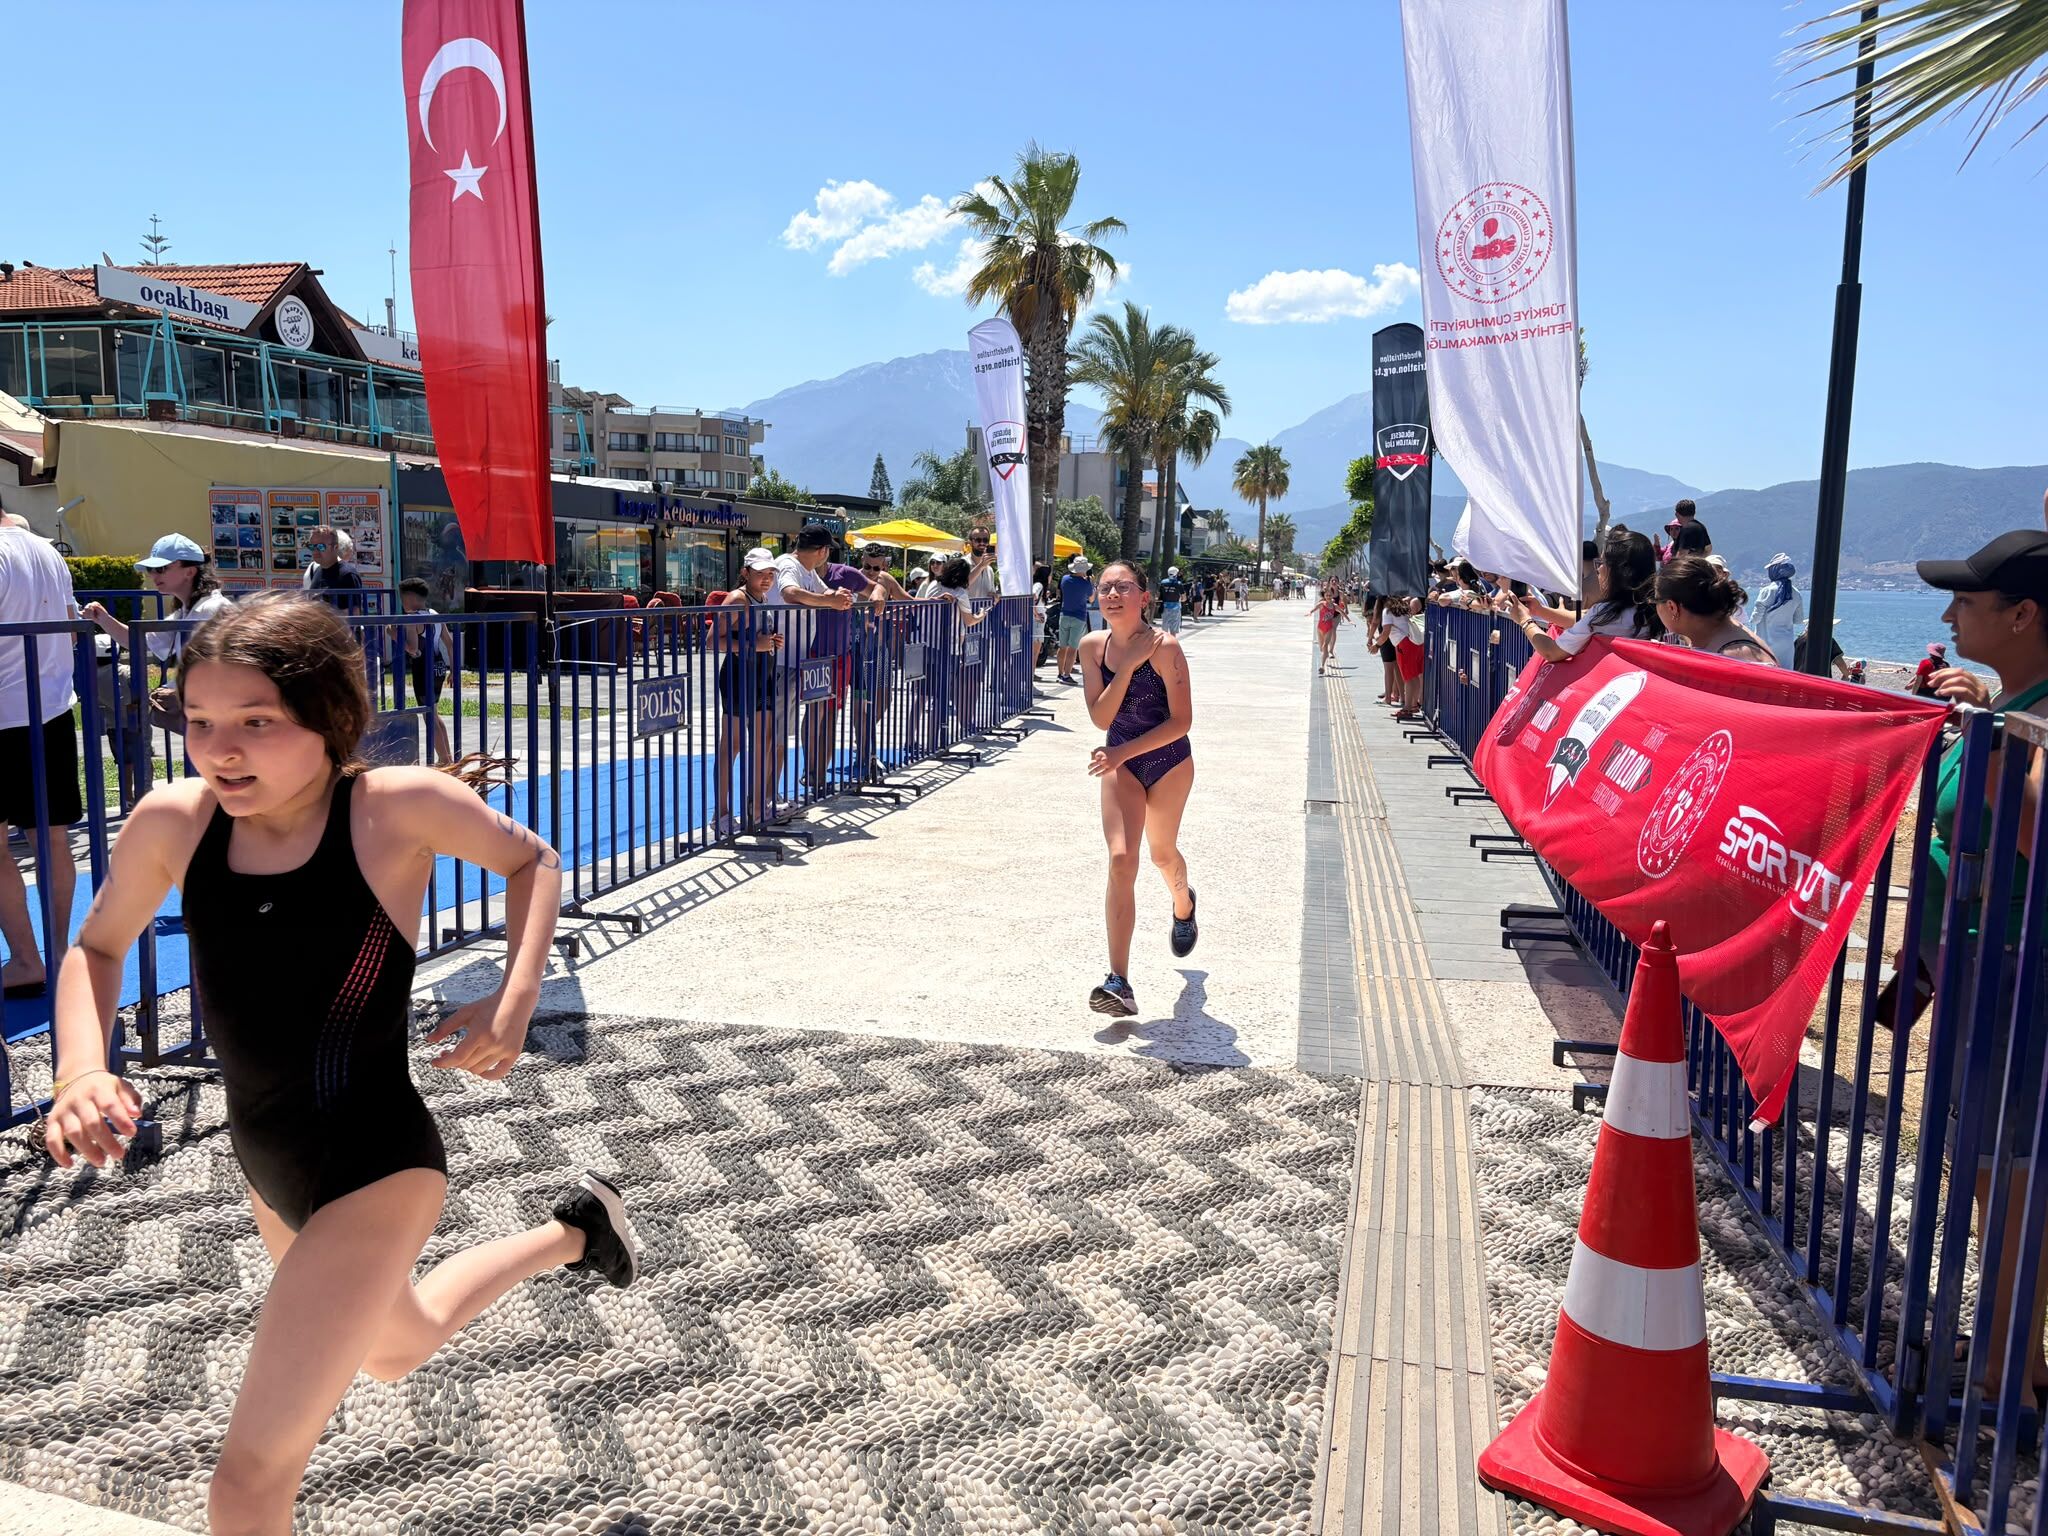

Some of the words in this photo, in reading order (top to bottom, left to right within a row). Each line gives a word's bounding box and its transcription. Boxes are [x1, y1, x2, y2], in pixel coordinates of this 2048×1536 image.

[140, 285, 230, 320] ocakbaşı
[803, 664, 831, 691] POLİS
[639, 686, 682, 721] POLİS
[1715, 854, 1740, 874] TEŞKİLAT
[1719, 816, 1788, 885] SPOR
